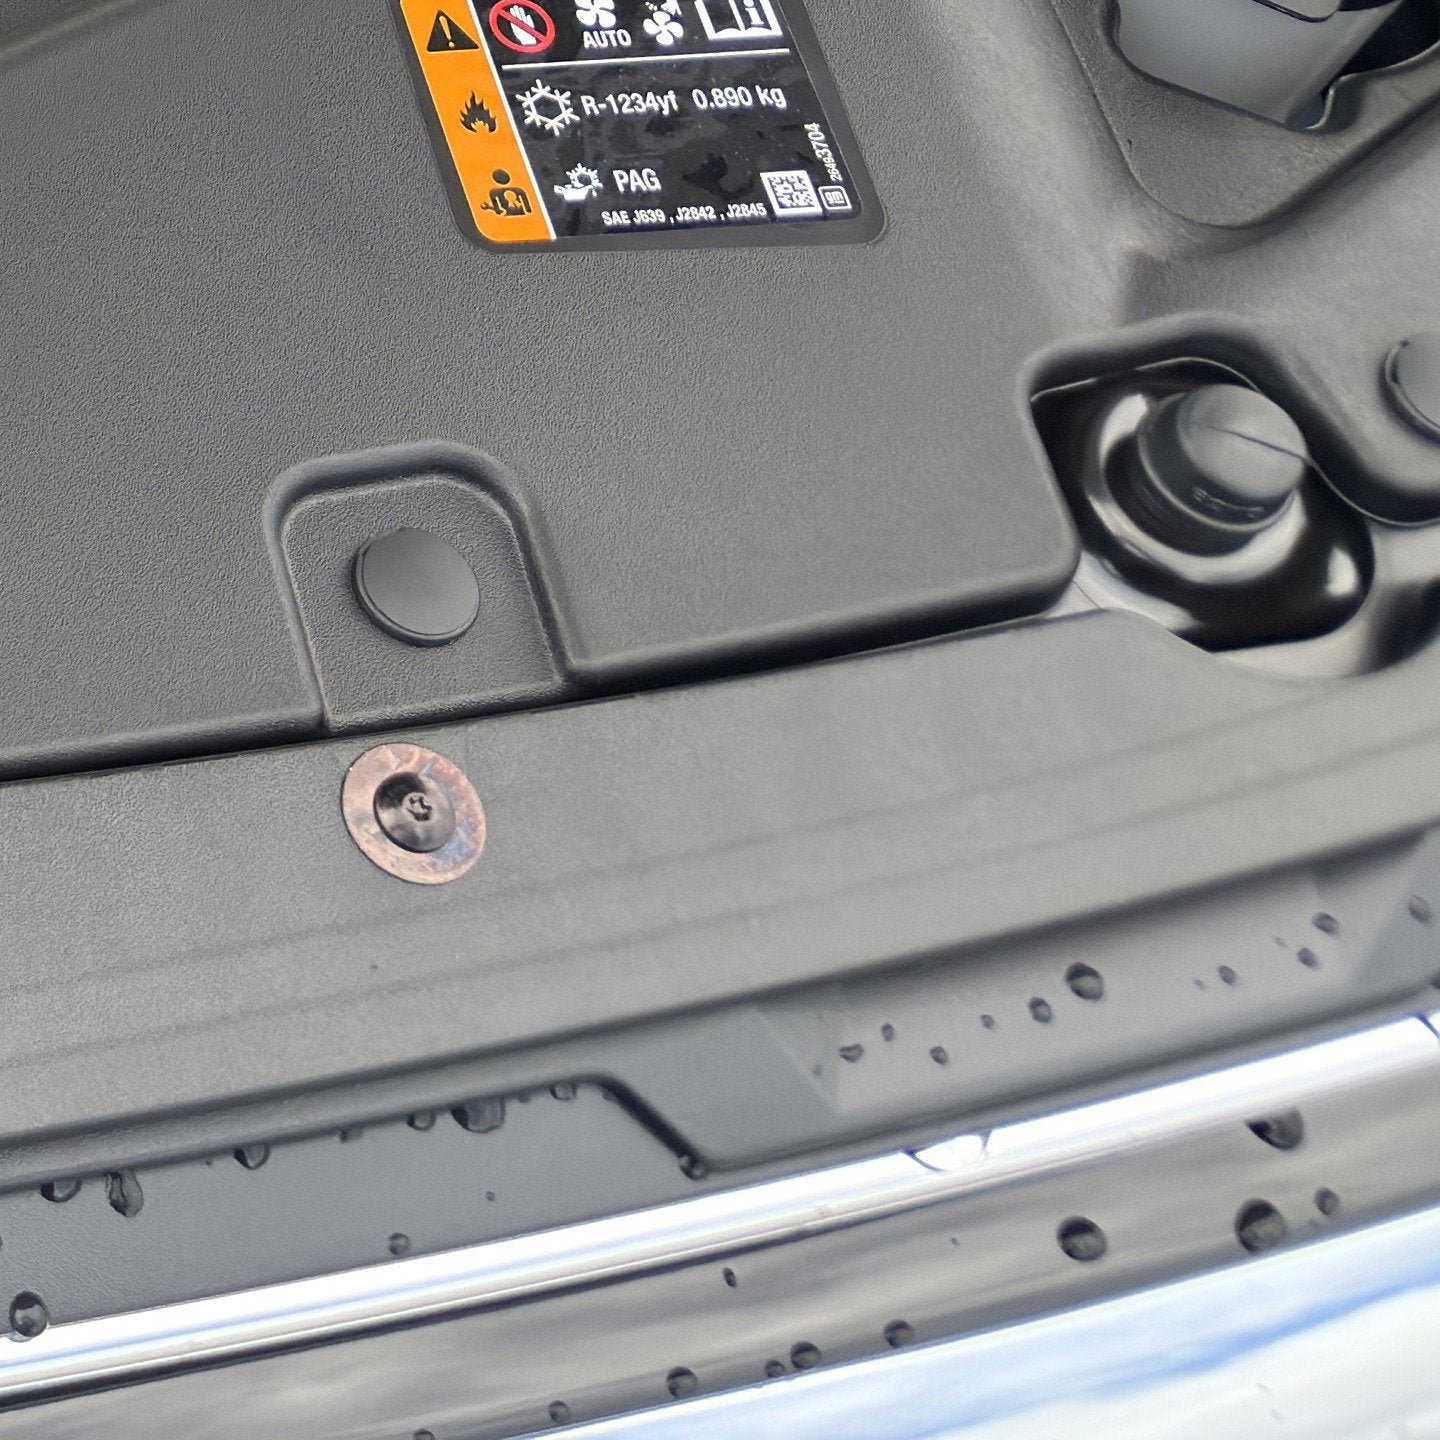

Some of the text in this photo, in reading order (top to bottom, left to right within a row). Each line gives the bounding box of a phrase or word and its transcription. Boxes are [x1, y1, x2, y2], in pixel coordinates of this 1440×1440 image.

[582, 28, 632, 50] AUTO
[581, 83, 787, 116] R-1234yf 0.890 kg
[810, 122, 844, 182] 26493704
[612, 168, 662, 193] PAG
[601, 209, 631, 226] SAE
[632, 208, 666, 224] J639
